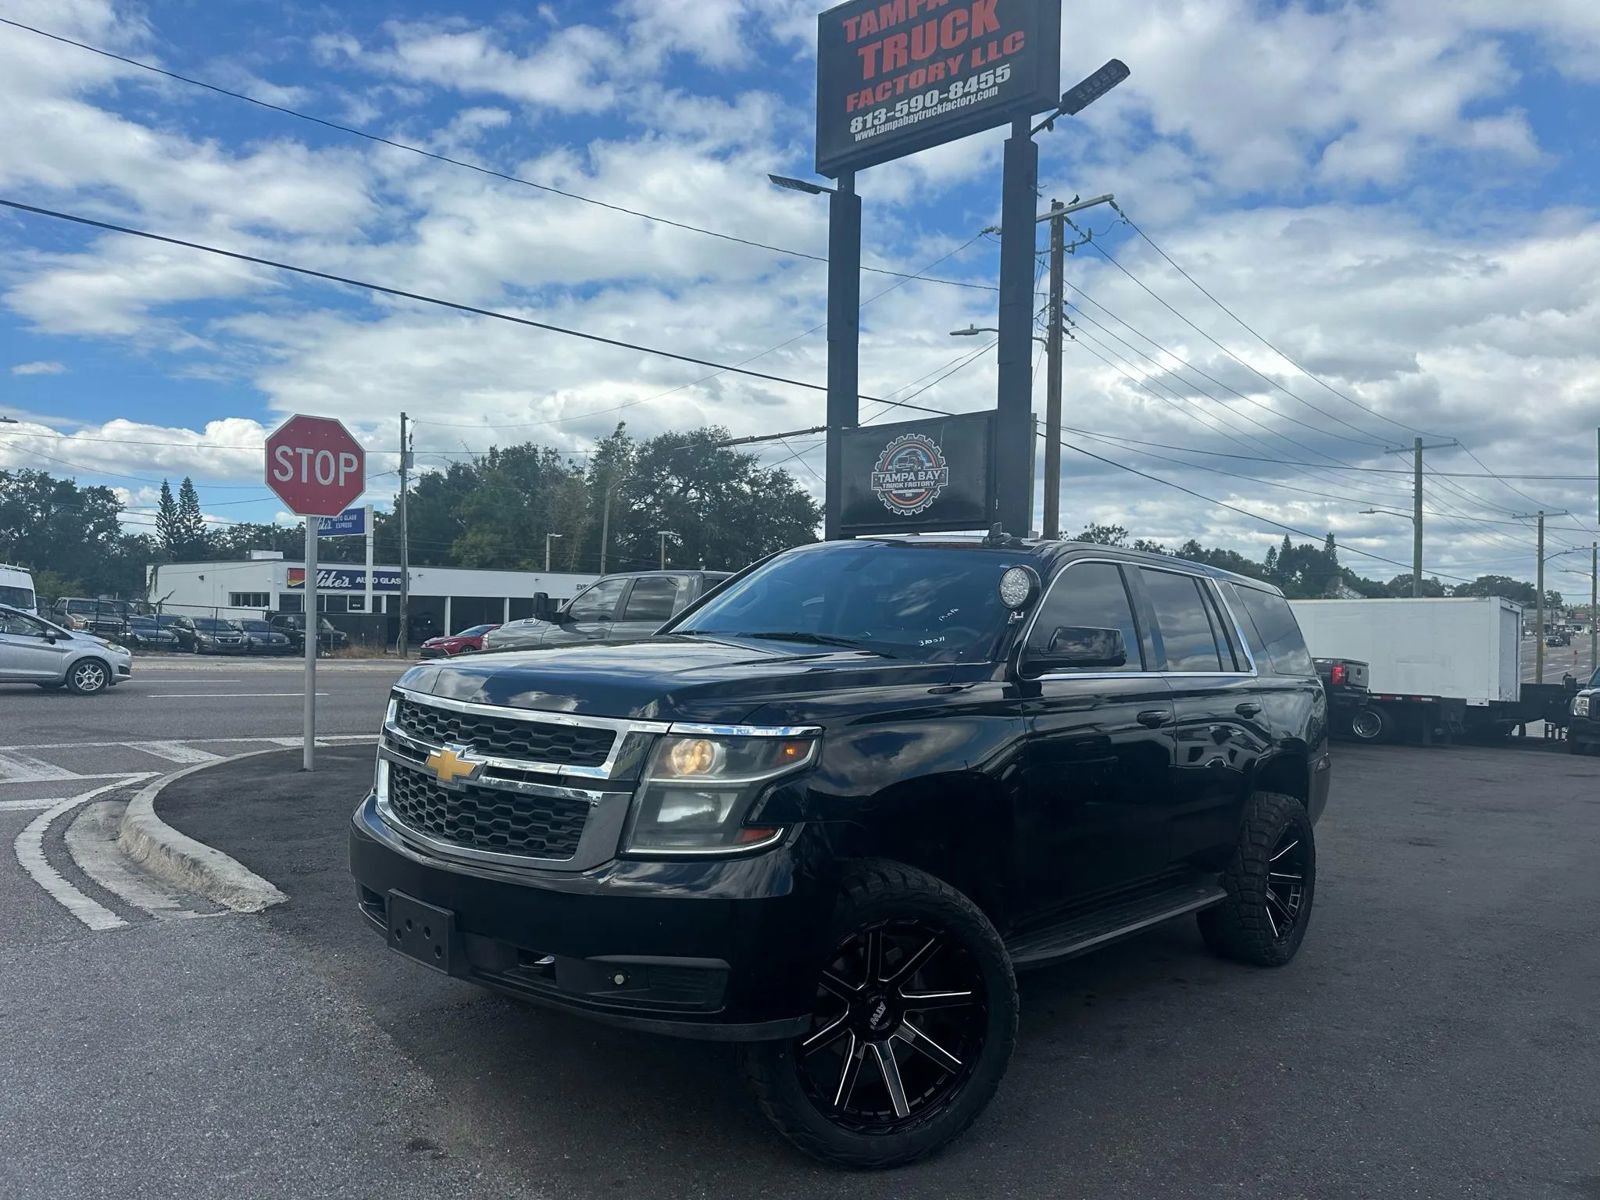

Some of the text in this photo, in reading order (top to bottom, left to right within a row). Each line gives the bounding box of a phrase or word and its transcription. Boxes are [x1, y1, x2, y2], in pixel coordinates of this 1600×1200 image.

[857, 0, 1000, 80] TRUCK
[846, 31, 1025, 113] FACTORY LLC
[850, 64, 1011, 134] 813-590-8455
[855, 86, 998, 142] www.tampabaytruckfactory.com
[273, 445, 359, 487] STOP
[878, 471, 941, 483] TAMPA BAY
